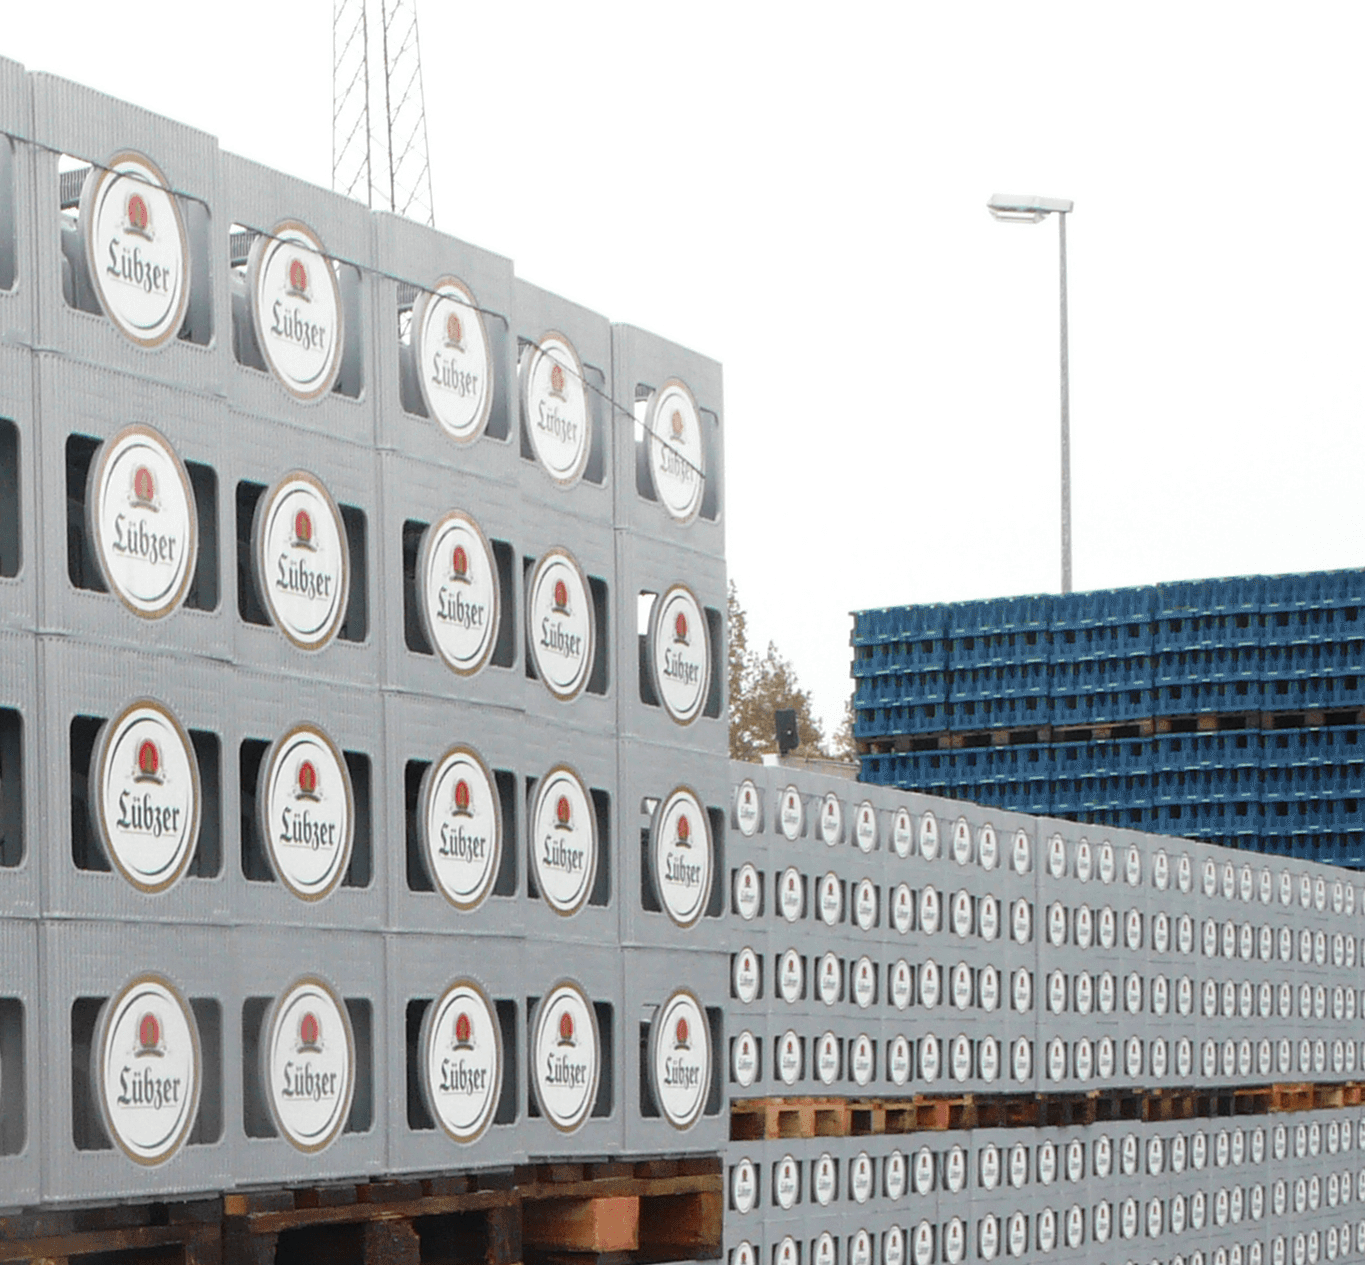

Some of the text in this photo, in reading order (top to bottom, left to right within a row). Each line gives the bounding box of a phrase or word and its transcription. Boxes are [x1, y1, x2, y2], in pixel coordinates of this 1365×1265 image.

[106, 237, 170, 294] Lübzer
[271, 299, 326, 351] Lübzer
[112, 512, 176, 565] Lübzer
[276, 552, 331, 601] Lübzer
[437, 585, 484, 630] Lübzer
[540, 616, 581, 658] Lübzer
[116, 789, 180, 838] Lübzer
[280, 806, 336, 851] Lübzer
[439, 822, 486, 863] Lübzer
[543, 834, 584, 874] Lübzer
[117, 1065, 181, 1110] Lübzer
[282, 1060, 337, 1102] Lübzer
[439, 1057, 487, 1096] Lübzer
[545, 1052, 587, 1089] Lübzer
